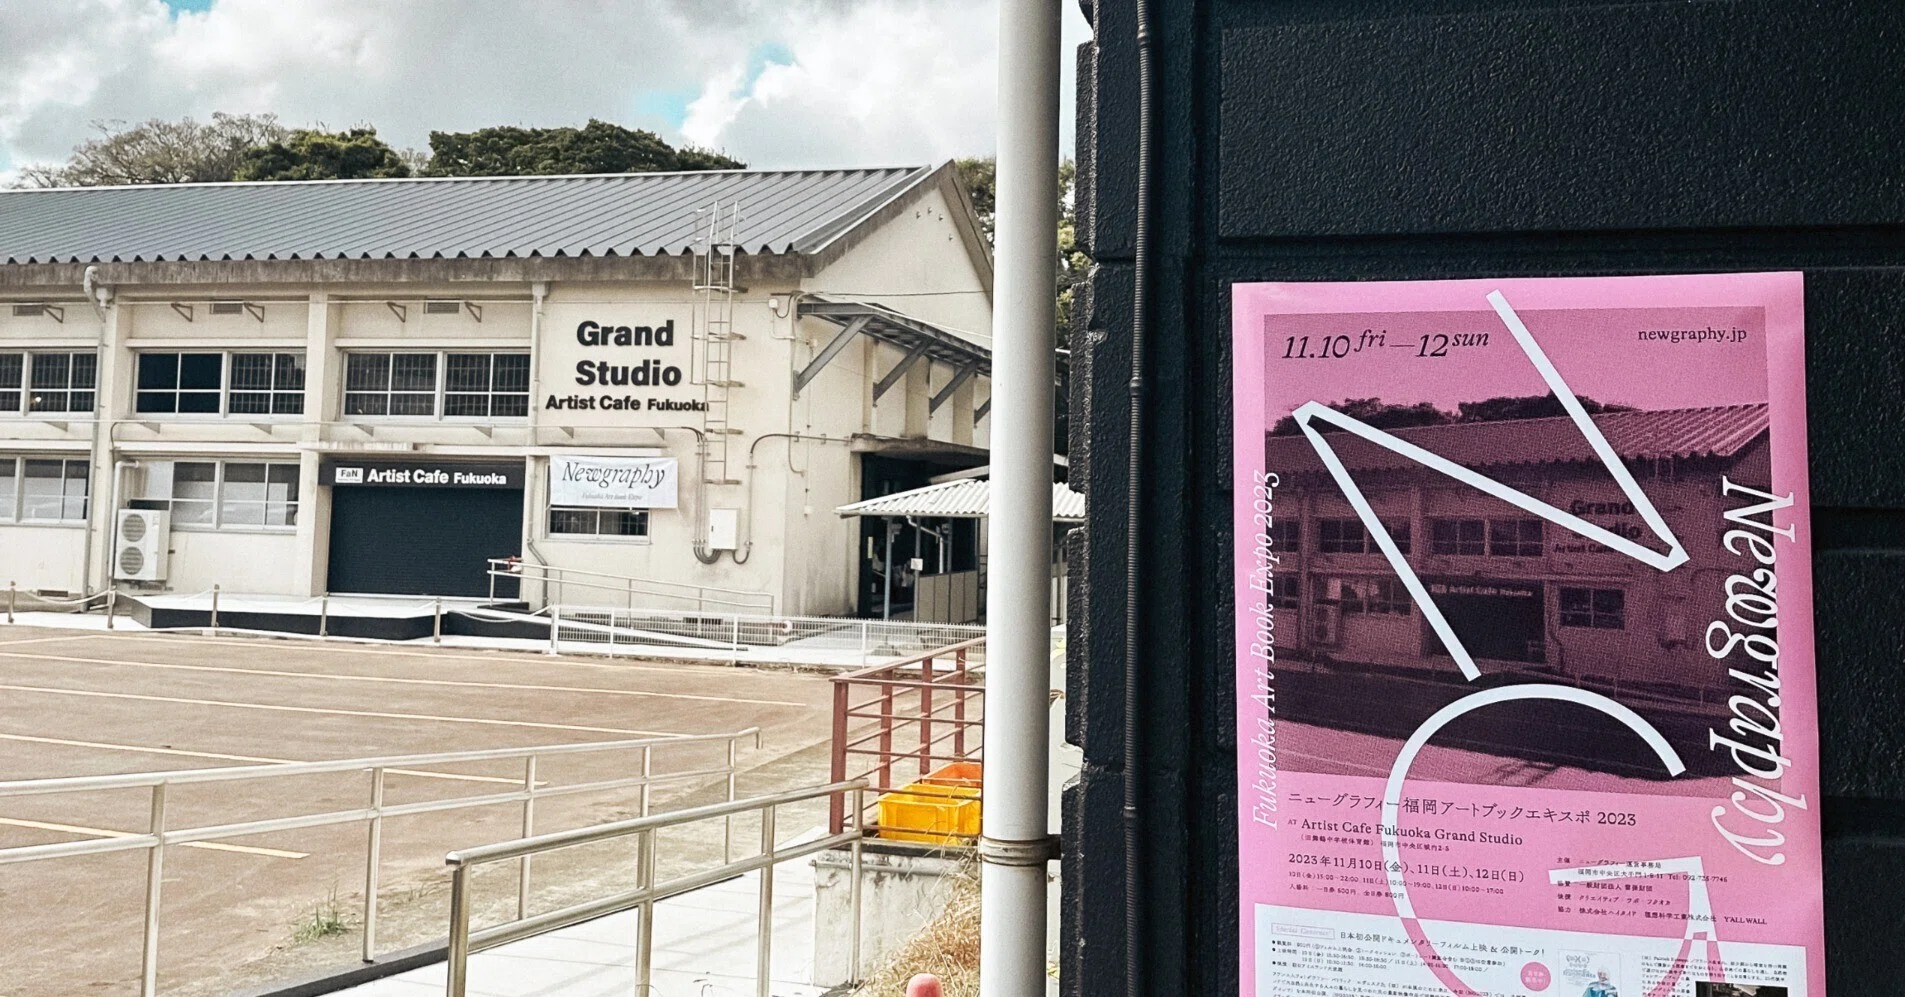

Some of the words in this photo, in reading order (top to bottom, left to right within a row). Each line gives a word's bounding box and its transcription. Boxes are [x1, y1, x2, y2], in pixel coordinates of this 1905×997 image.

[576, 320, 674, 346] Grand
[1282, 335, 1350, 358] 11.10
[1353, 329, 1386, 352] fri
[1415, 334, 1449, 357] 12
[1452, 332, 1489, 347] sun
[1638, 327, 1747, 343] newgraphy.jp
[575, 359, 682, 386] Studio
[545, 394, 596, 410] Artist
[599, 395, 641, 410] Cafe
[647, 398, 709, 412] Fukuoka
[367, 469, 410, 483] Artist
[413, 469, 449, 484] Cafe
[453, 472, 507, 485] Fukuoka
[562, 461, 666, 489] Newgraphy
[1253, 470, 1280, 529] 2023
[1249, 533, 1280, 597] Expo
[1249, 603, 1275, 664] Book
[1705, 475, 1807, 865] Newgraphy
[1251, 667, 1276, 713] Art
[1250, 717, 1278, 831] Fukuoka
[1301, 818, 1339, 832] Artist
[1342, 820, 1372, 834] Cafe
[1376, 824, 1431, 839] Fukuoka
[1435, 829, 1475, 842] Grand
[1479, 832, 1523, 846] Studio
[1598, 811, 1637, 826] 2023
